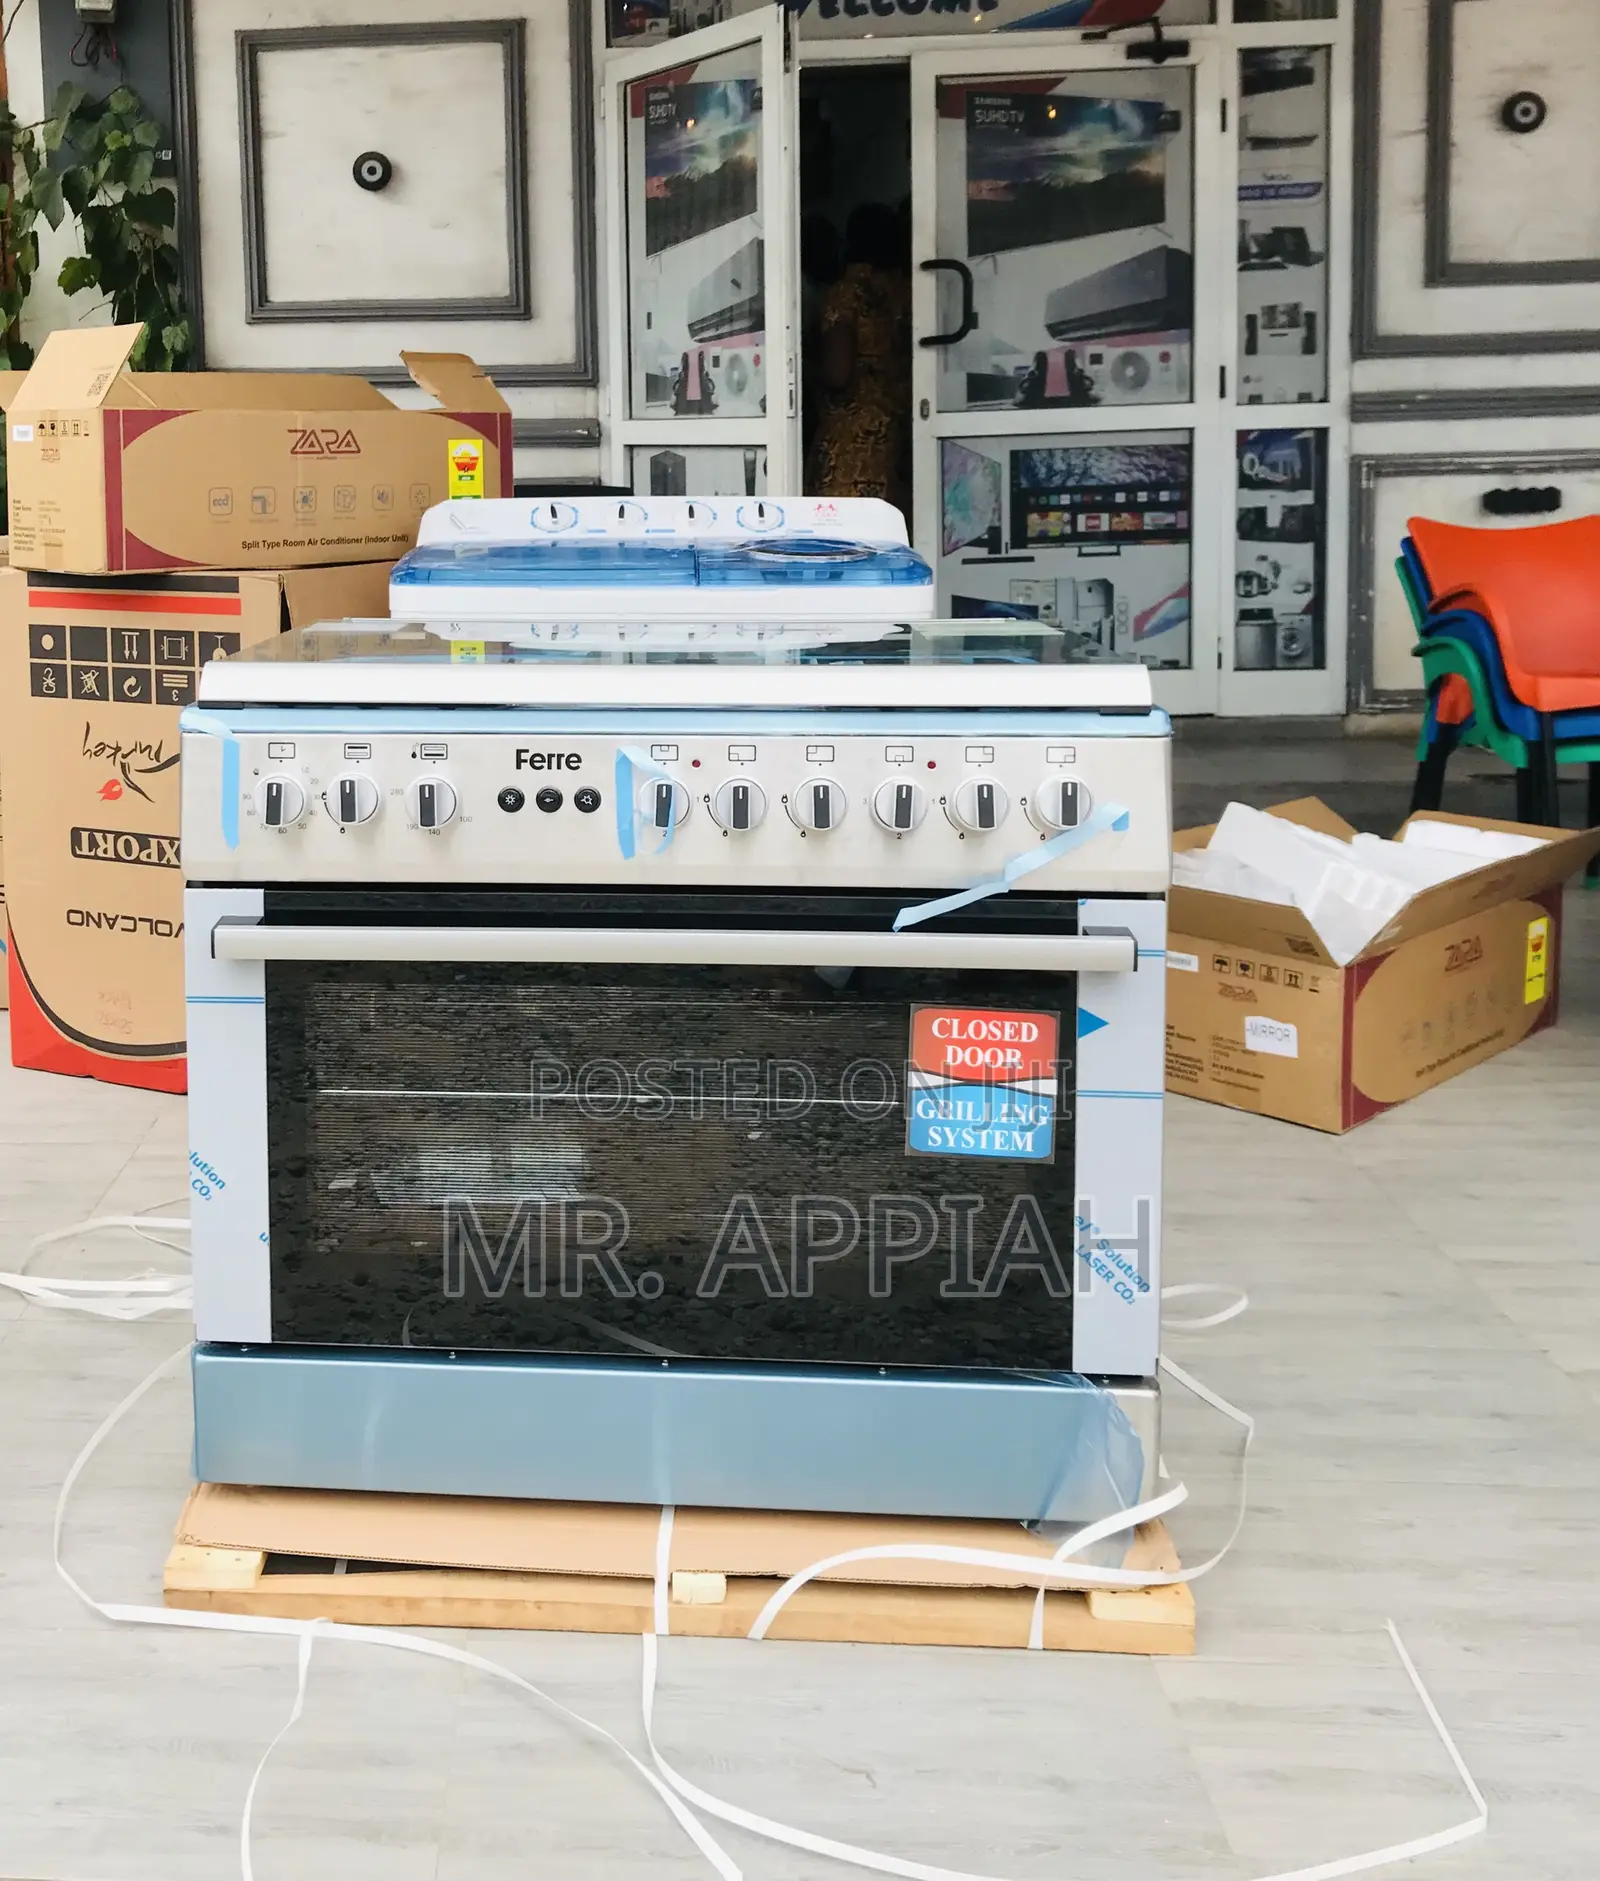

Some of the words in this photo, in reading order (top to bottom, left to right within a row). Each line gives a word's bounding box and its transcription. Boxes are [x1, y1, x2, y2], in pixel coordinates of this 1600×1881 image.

[287, 428, 361, 455] ZARA
[241, 540, 260, 551] Split
[262, 540, 281, 550] Type
[282, 539, 306, 547] Room
[307, 537, 319, 546] Air
[320, 535, 363, 546] Conditioner
[515, 748, 583, 771] Ferre
[75, 830, 180, 867] XPORT
[931, 1017, 1039, 1043] CLOSED
[945, 1045, 1023, 1070] DOOR
[916, 1098, 1048, 1126] GRILLING
[927, 1125, 1035, 1152] SYSTEM
[188, 1151, 226, 1190] lution
[1075, 1243, 1116, 1283] LASER
[1096, 1238, 1151, 1293] Solution
